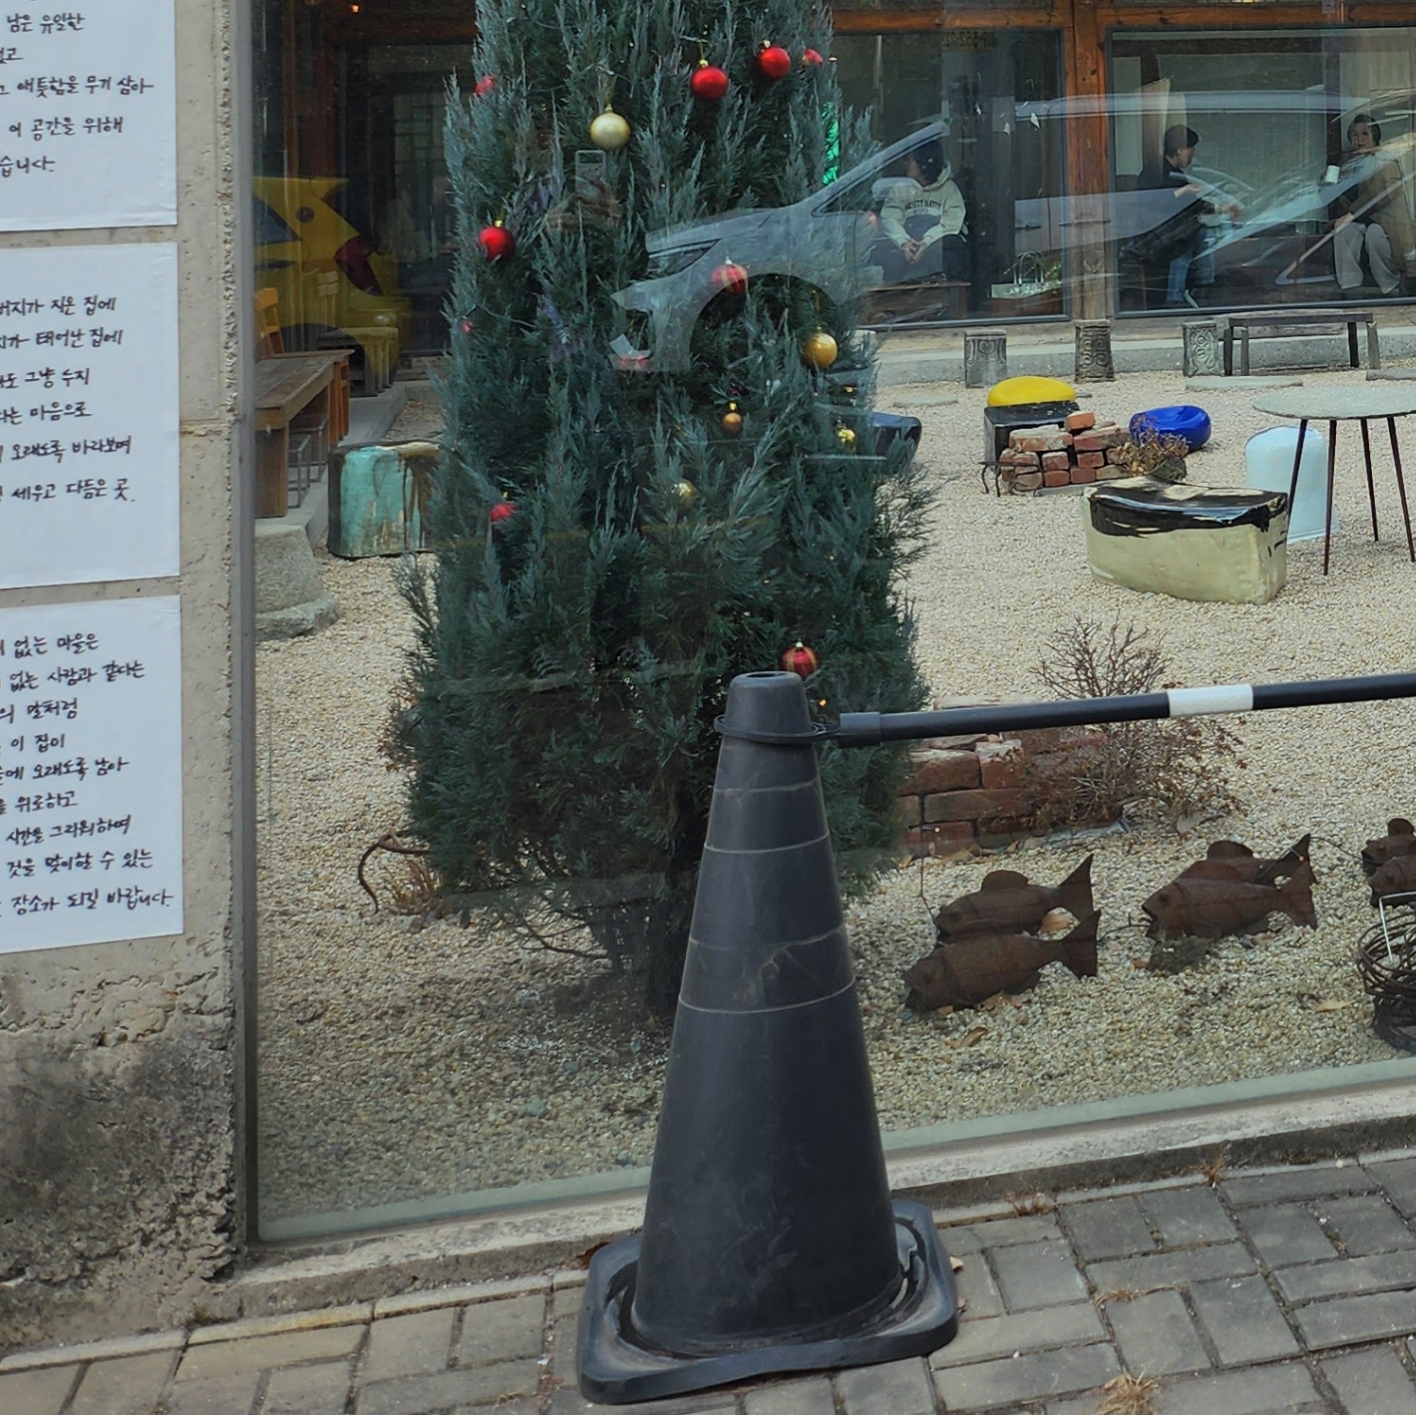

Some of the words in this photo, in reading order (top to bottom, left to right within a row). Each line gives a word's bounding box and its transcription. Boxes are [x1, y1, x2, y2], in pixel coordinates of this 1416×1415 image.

[7, 13, 33, 33] 남은
[40, 13, 85, 34] 유일한
[17, 76, 79, 98] 애틋함을
[85, 76, 112, 94] 무기
[117, 75, 154, 95] 삼아
[31, 117, 75, 141] 공간을
[83, 116, 123, 134] 위해
[50, 296, 75, 315] 지은
[84, 295, 116, 316] 집에
[36, 329, 85, 348] 태어난
[89, 327, 123, 347] 집에
[24, 367, 56, 388] 그냥
[30, 401, 92, 421] 마음으로
[11, 440, 66, 463] 오래도록
[72, 435, 131, 455] 바라보며
[11, 484, 56, 502] 세우고
[66, 479, 107, 499] 다듬은
[14, 636, 47, 659] 없는
[57, 633, 98, 654] 마을은
[10, 670, 39, 692] 없는
[47, 667, 98, 686] 사람과
[102, 660, 145, 682] 같다는
[11, 736, 24, 751] 이
[35, 733, 65, 753] 집이
[32, 757, 89, 781] 오래도록
[95, 757, 129, 776] 남아
[15, 791, 78, 812] 위로하고
[6, 827, 44, 846] 시간을
[7, 858, 35, 878] 것을
[45, 852, 93, 874] 맞이할
[100, 851, 114, 870] 수
[122, 849, 152, 868] 있는
[11, 894, 60, 915] 장소가
[67, 888, 98, 910] 되길
[107, 885, 174, 910] 바랍니다.
